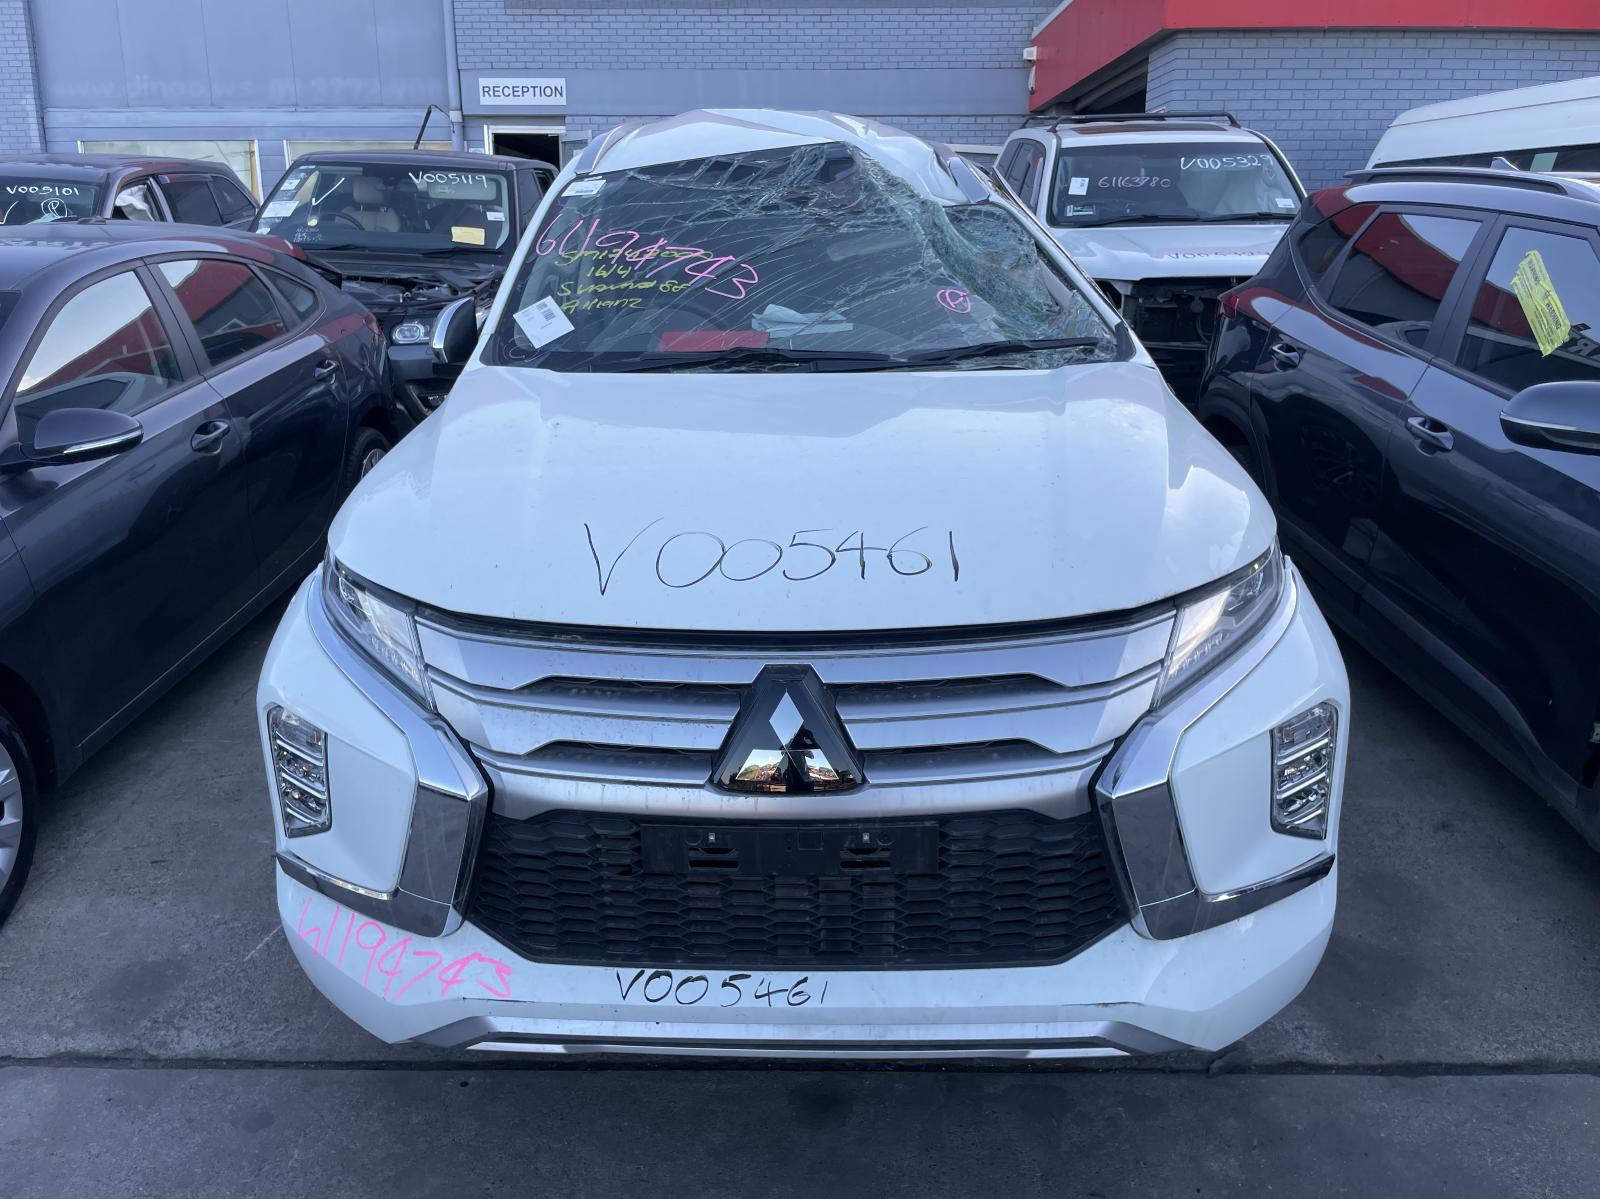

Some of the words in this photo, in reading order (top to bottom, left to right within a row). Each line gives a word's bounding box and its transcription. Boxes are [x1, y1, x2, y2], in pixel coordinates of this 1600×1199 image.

[482, 85, 563, 103] RECEPTION
[1180, 154, 1273, 170] V005329
[408, 171, 487, 189] V005119
[6, 185, 79, 196] V005101
[584, 516, 960, 596] V005461
[616, 969, 828, 1007] V005461
